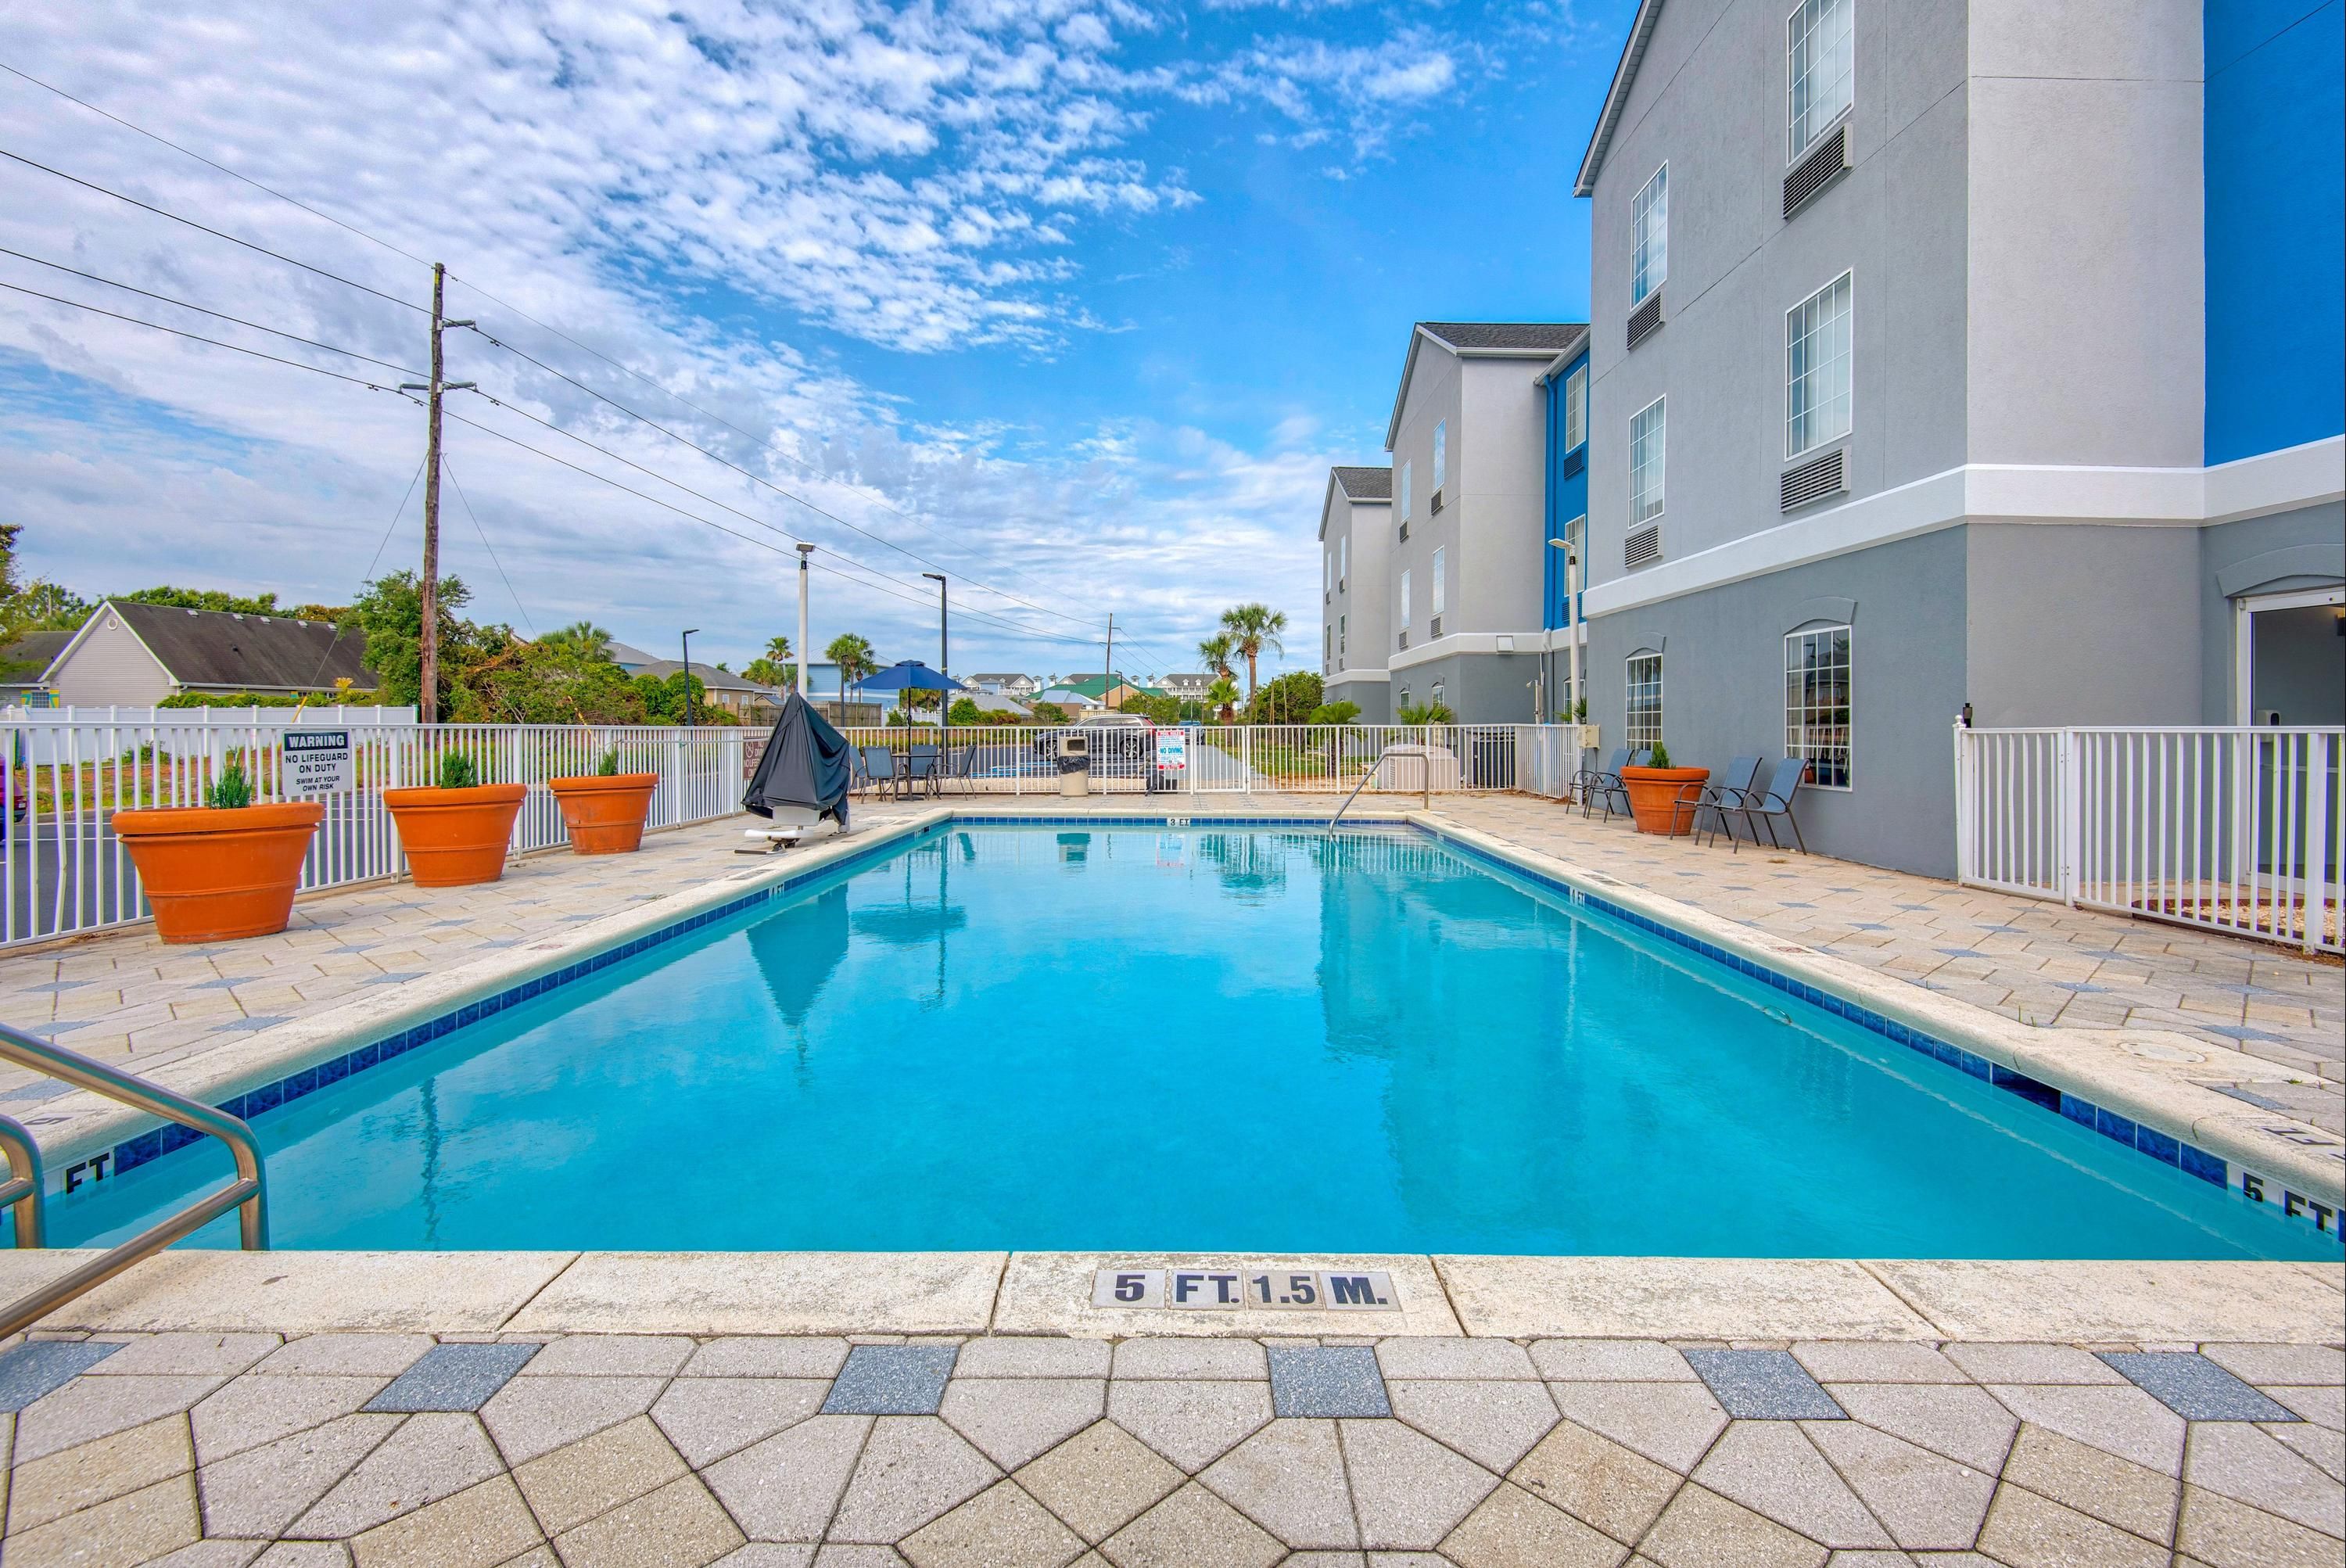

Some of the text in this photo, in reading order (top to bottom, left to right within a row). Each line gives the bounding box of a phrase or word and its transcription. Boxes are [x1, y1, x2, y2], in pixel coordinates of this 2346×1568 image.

[288, 735, 345, 748] WARNING
[285, 752, 348, 763] NO LIFEGUARD
[299, 763, 336, 773] ON DUTY
[2243, 1172, 2264, 1202] 5
[1114, 1274, 1388, 1305] 5 FT. 1.5 M.
